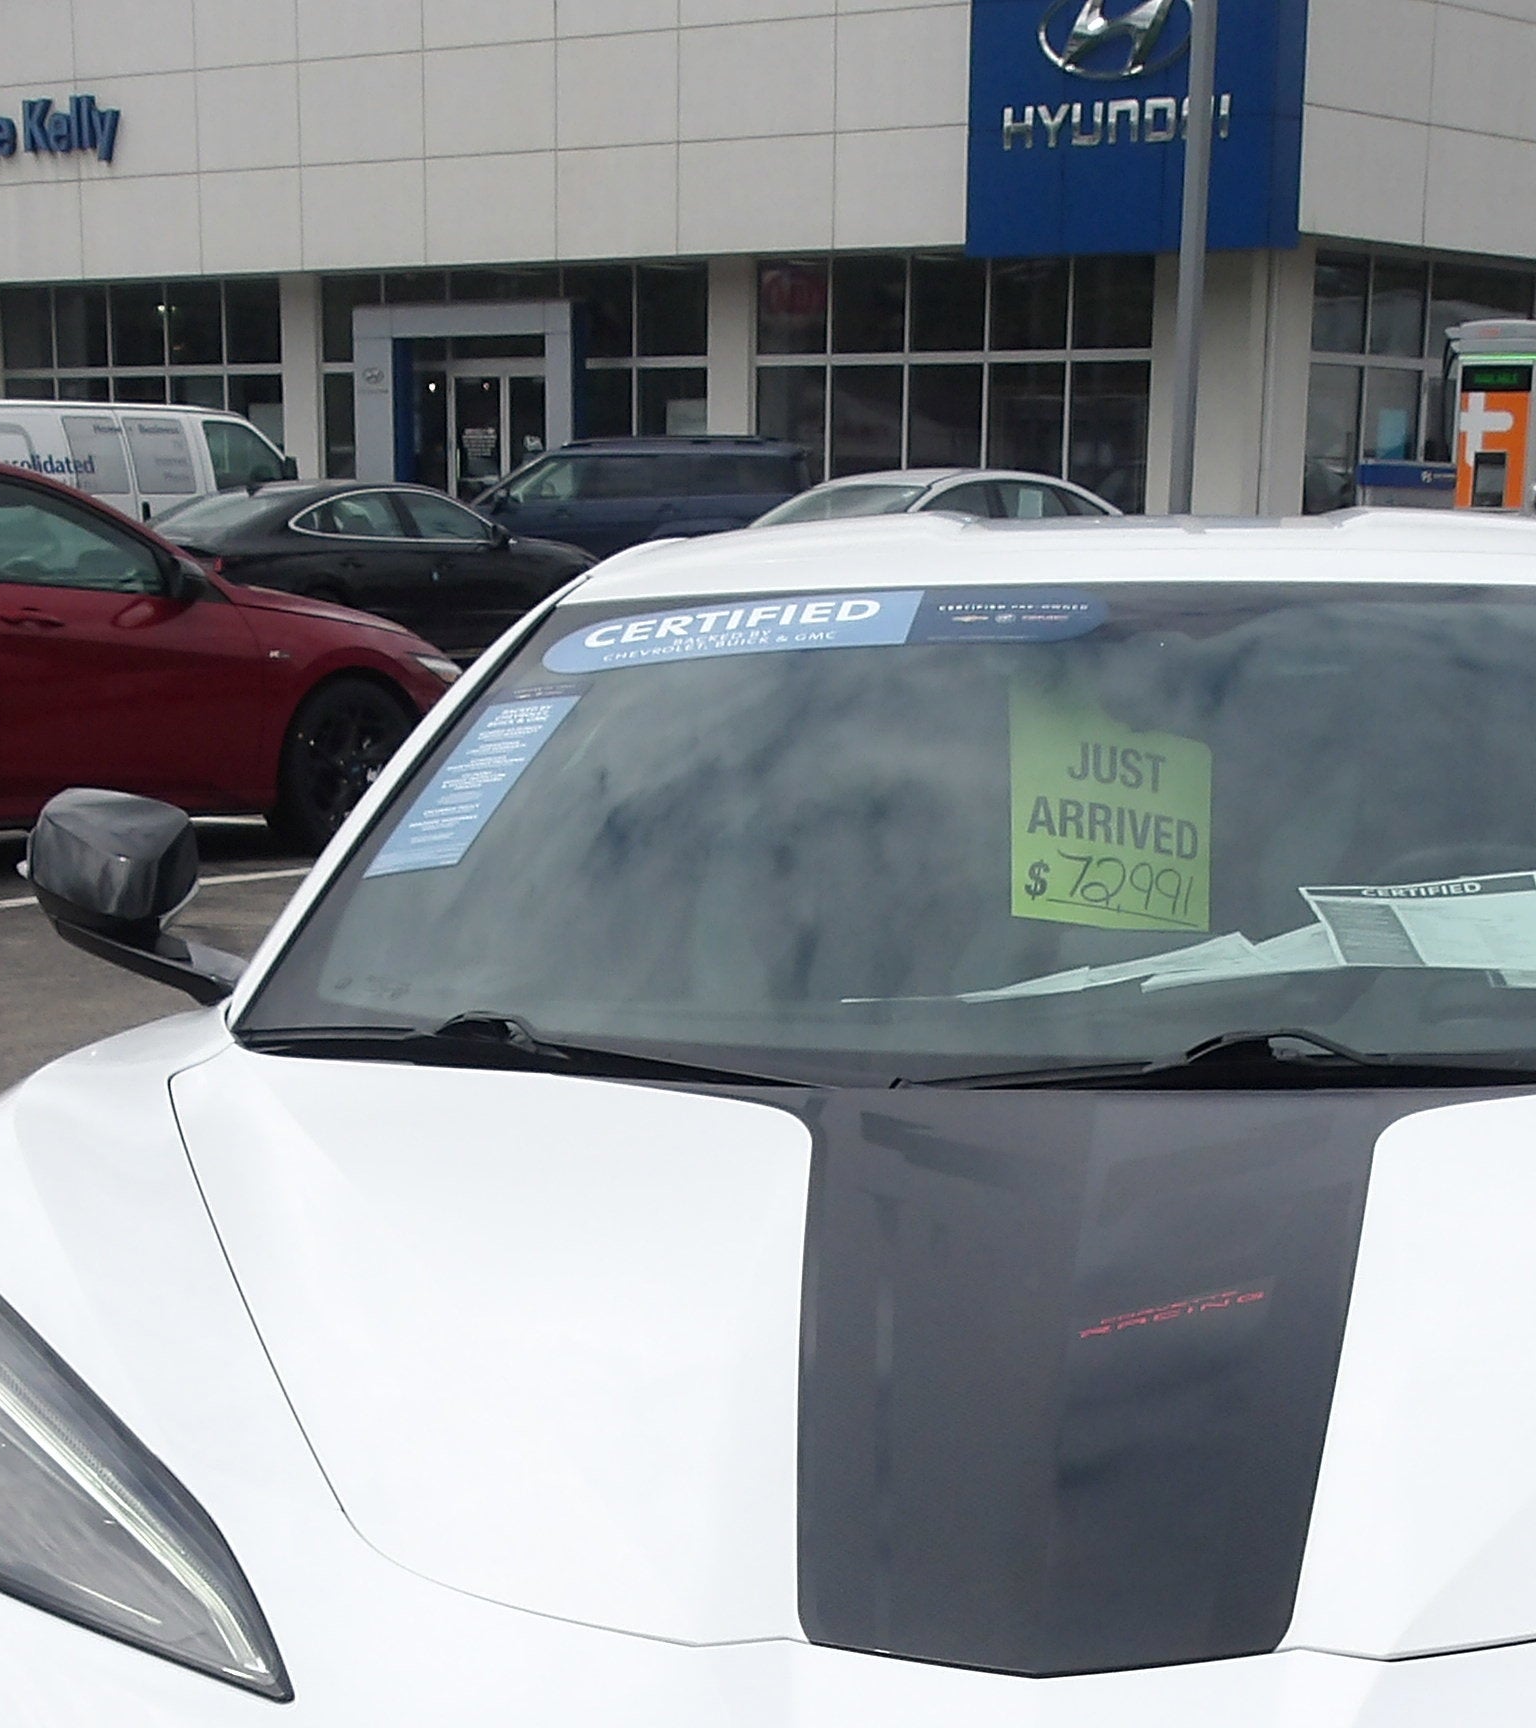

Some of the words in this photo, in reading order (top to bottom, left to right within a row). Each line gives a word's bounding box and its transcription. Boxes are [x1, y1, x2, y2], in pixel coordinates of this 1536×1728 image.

[22, 94, 121, 163] Kelly
[584, 599, 882, 648] CERTIFIED
[673, 631, 744, 646] BACKED
[750, 628, 771, 638] BY
[715, 636, 769, 649] BUICK
[795, 630, 837, 642] GMC
[1067, 741, 1167, 794] JUST
[1026, 795, 1199, 861] ARRIVED
[1361, 881, 1482, 897] CERTIFIED
